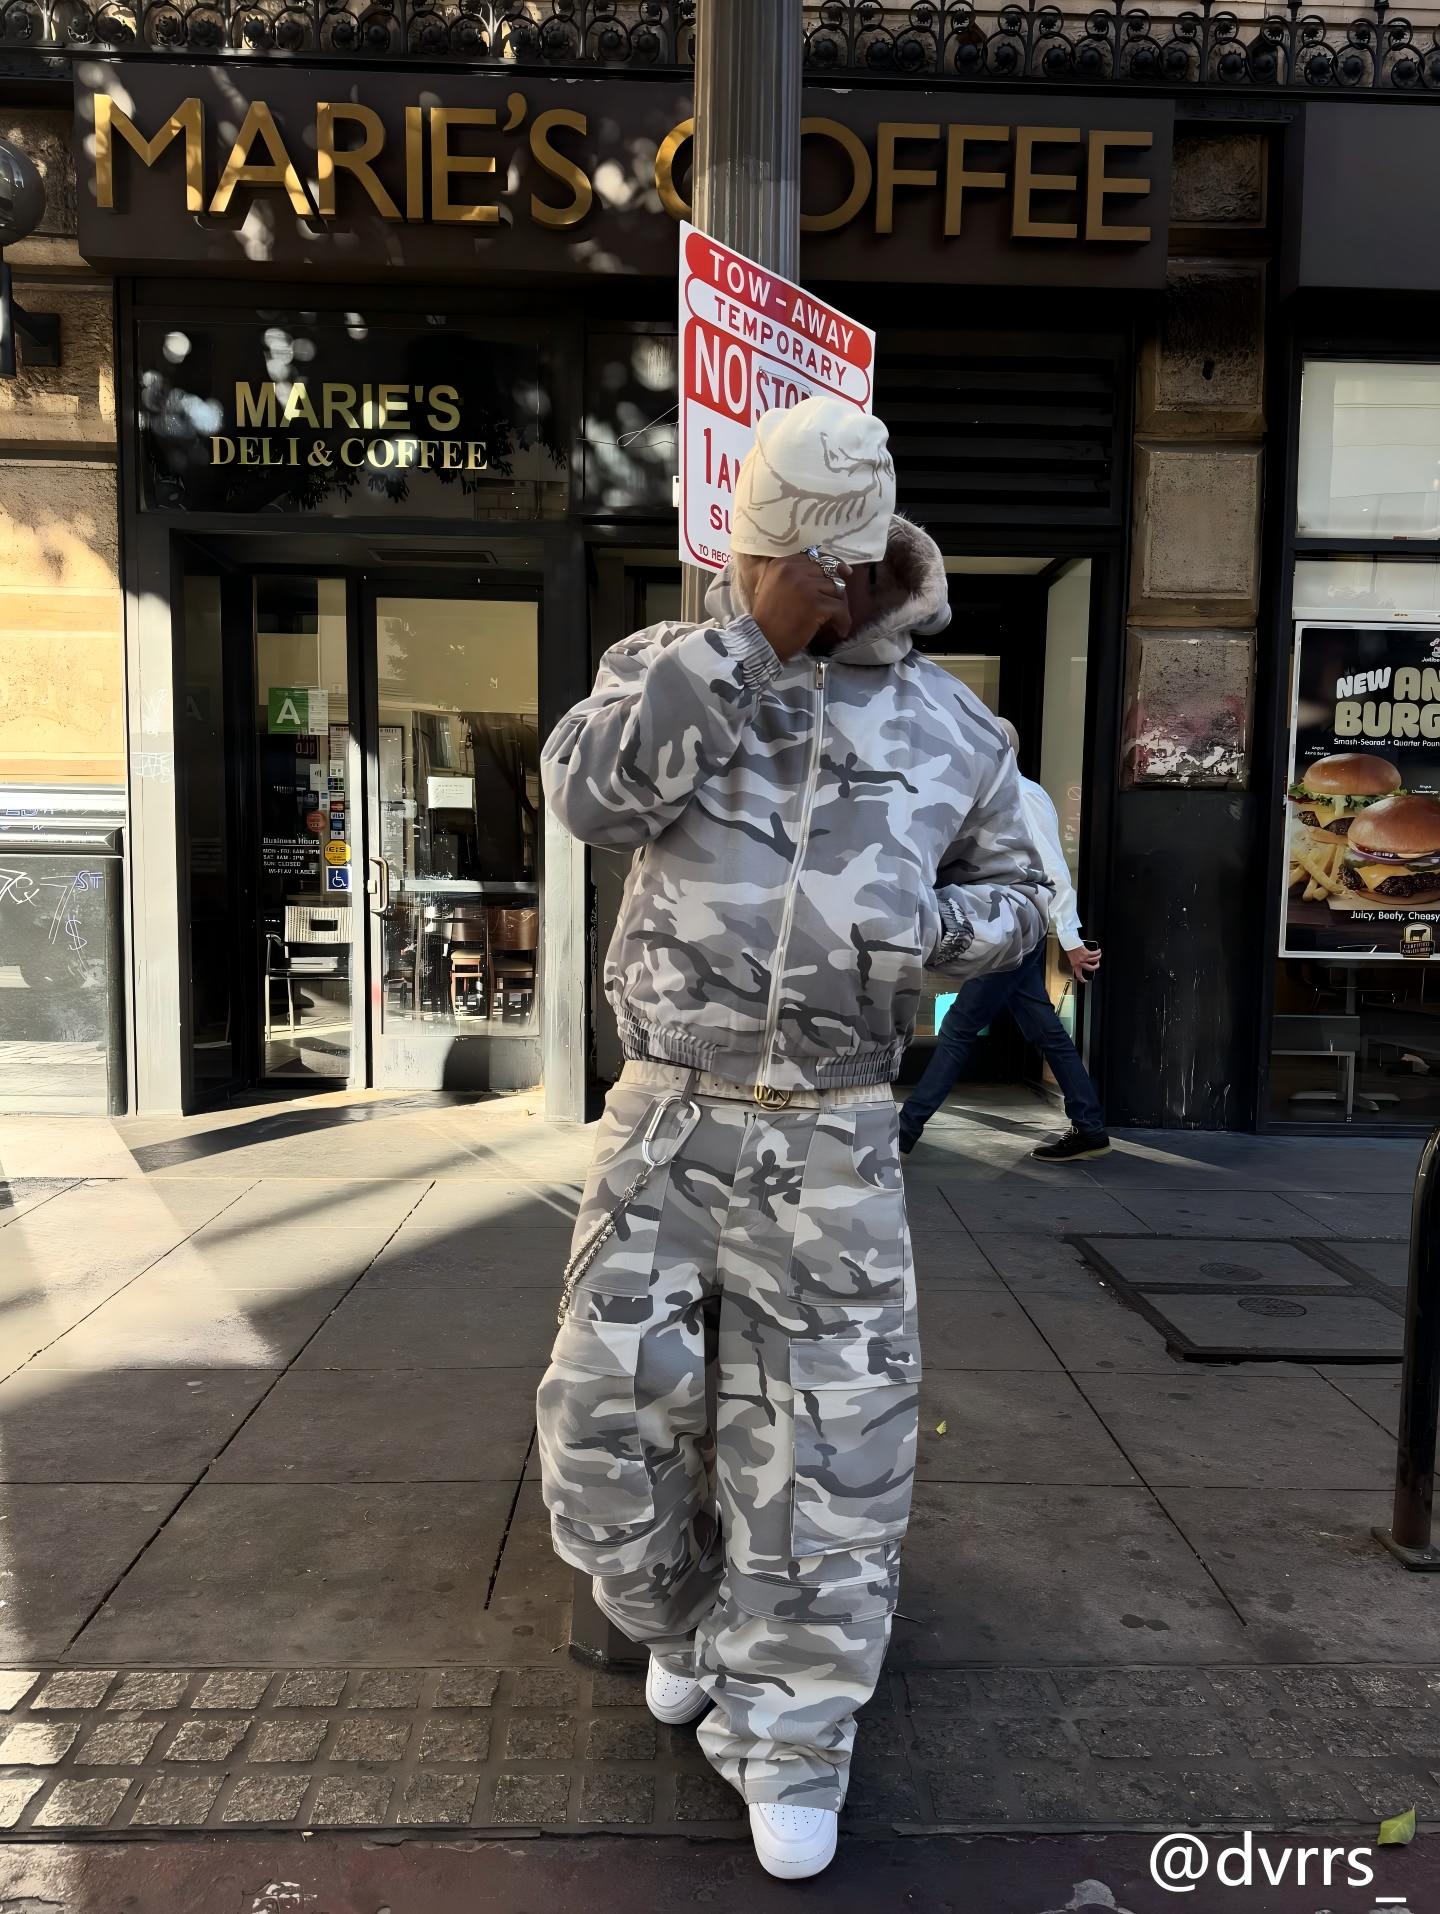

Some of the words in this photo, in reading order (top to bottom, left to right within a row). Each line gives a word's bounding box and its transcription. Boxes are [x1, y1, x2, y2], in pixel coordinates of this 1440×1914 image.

[714, 295, 847, 387] TEMPORARY
[695, 325, 748, 416] NO
[235, 381, 462, 432] MARIE'S
[209, 436, 301, 466] DELI
[307, 439, 334, 467] &
[341, 437, 488, 470] COFFEE
[698, 543, 709, 557] TO
[1336, 666, 1392, 699] NEW
[276, 698, 301, 725] A
[1393, 739, 1421, 748] Quarter
[1350, 910, 1375, 921] Juicy,
[1378, 911, 1405, 921] Beefy,
